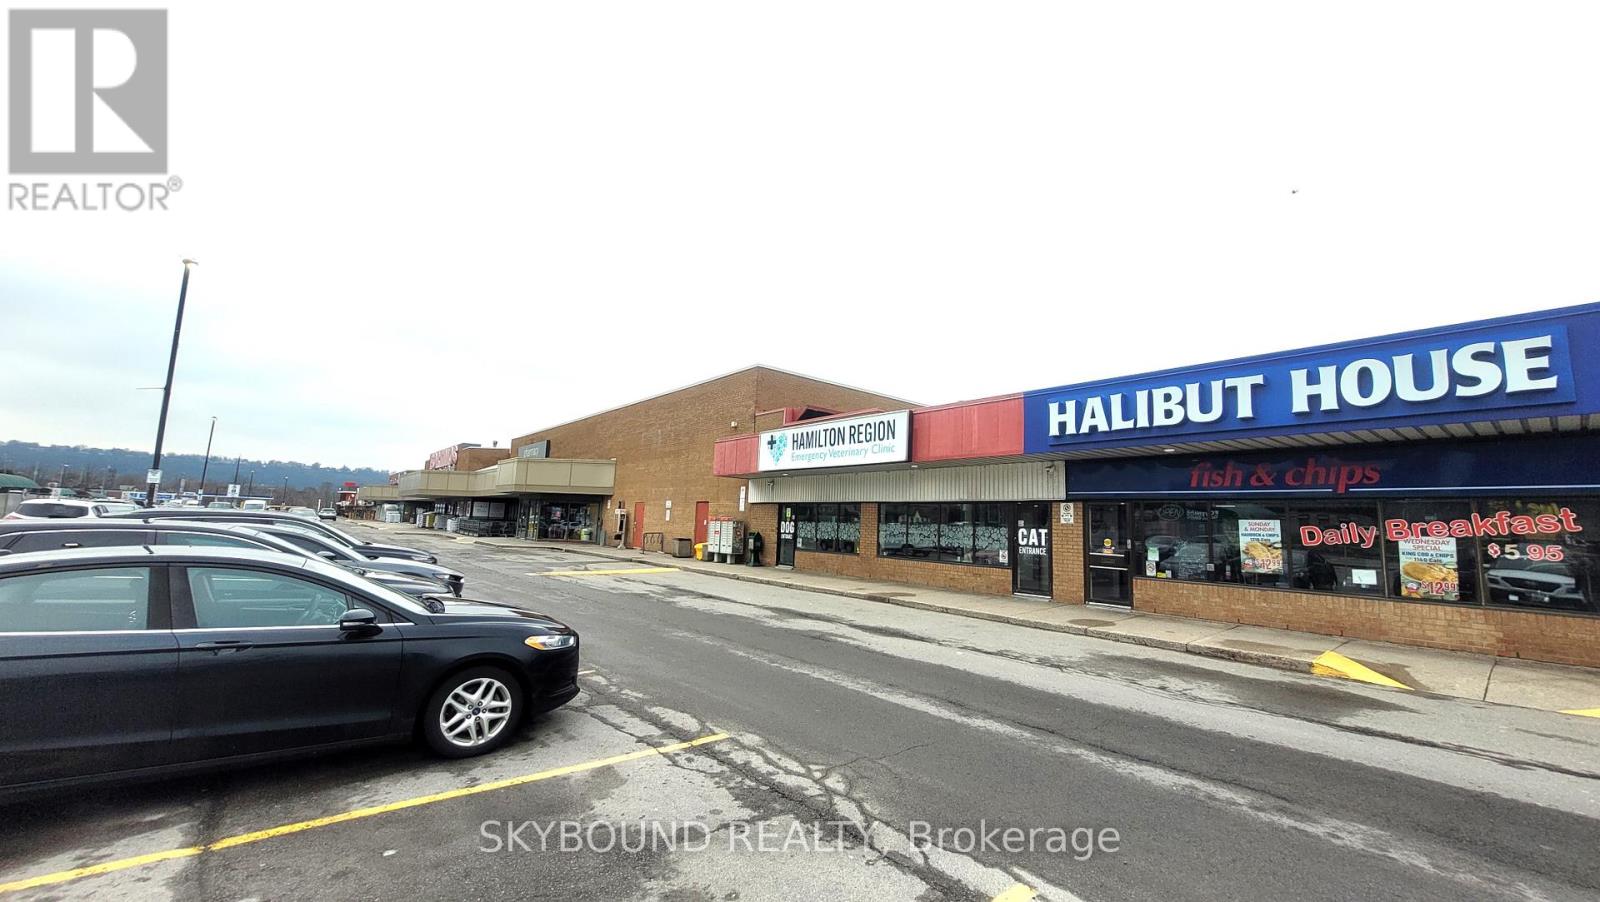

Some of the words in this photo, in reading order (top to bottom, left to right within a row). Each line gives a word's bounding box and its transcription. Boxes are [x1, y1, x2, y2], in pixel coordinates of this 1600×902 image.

[1048, 373, 1266, 438] HALIBUT
[1289, 334, 1559, 415] HOUSE
[791, 425, 846, 451] HAMILTON
[849, 418, 897, 444] REGION
[791, 448, 828, 463] Emergency
[828, 446, 869, 460] Veterinary
[871, 442, 896, 455] Clinic
[1189, 461, 1243, 488] fish
[1250, 462, 1278, 487] &
[1285, 457, 1381, 494] chips
[780, 520, 795, 534] DOG
[1018, 528, 1048, 547] CAT
[1300, 521, 1377, 550] Daily
[1385, 507, 1583, 542] Breakfast
[1018, 546, 1047, 556] ENTRANCE
